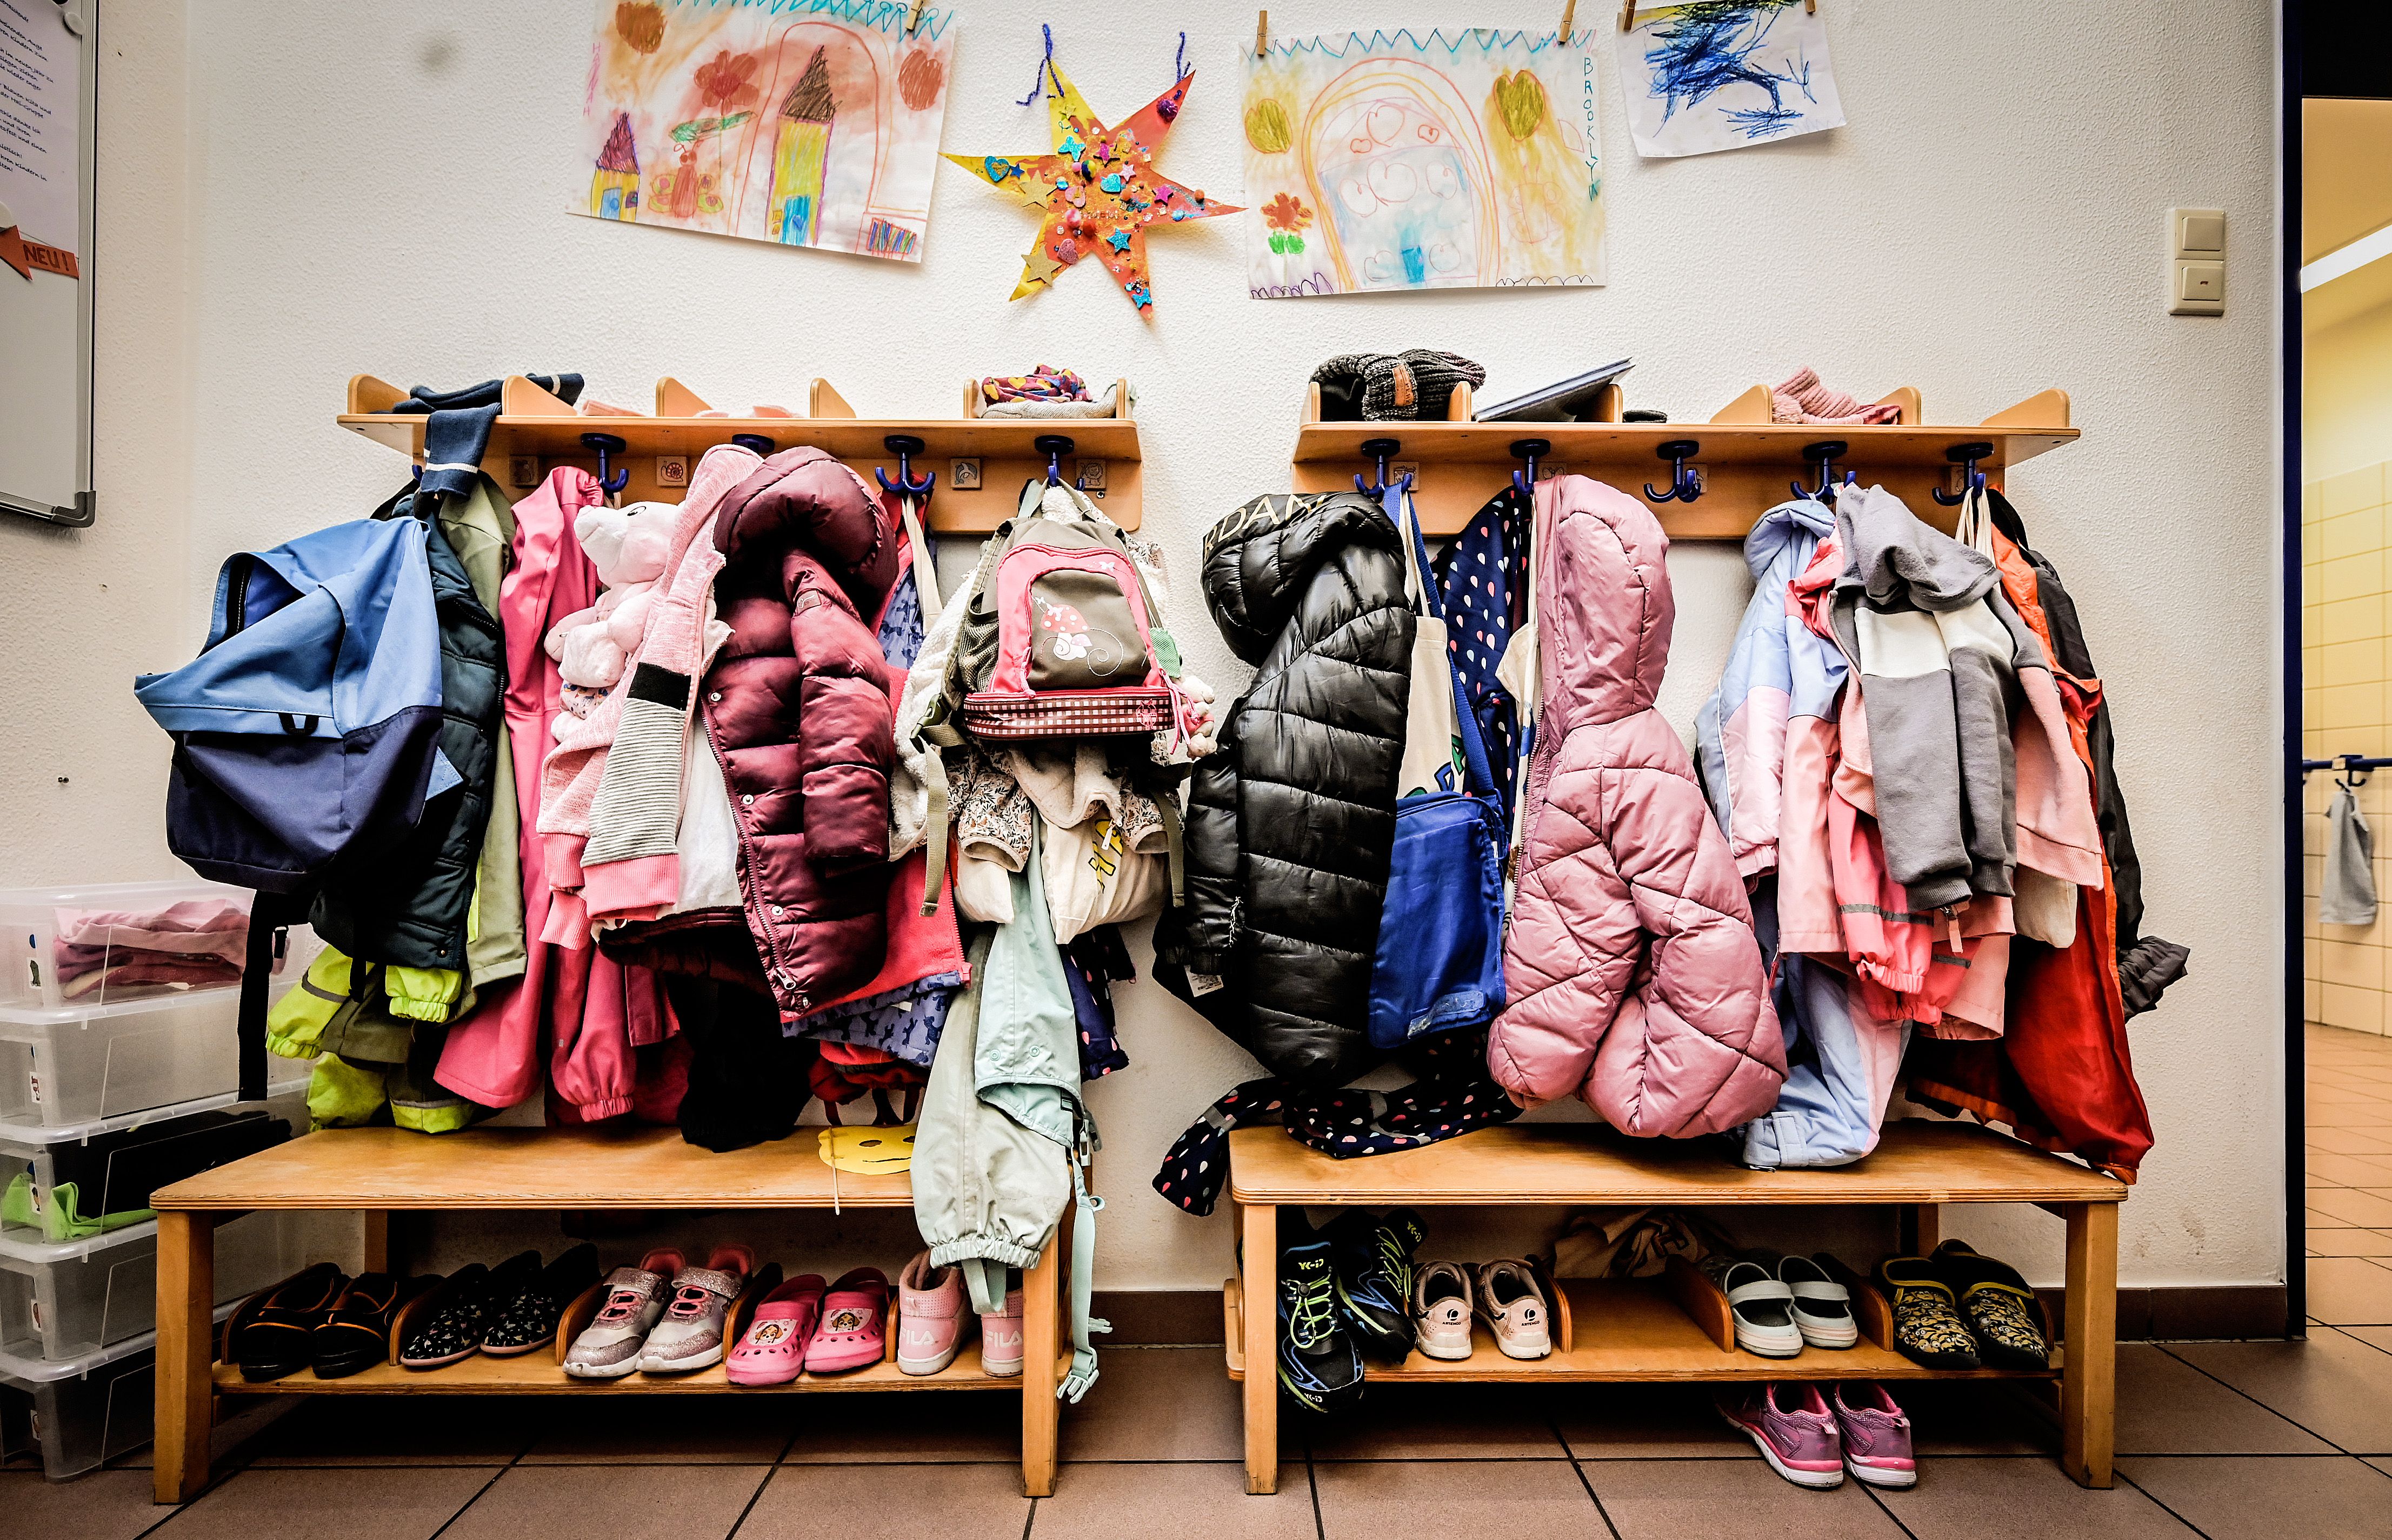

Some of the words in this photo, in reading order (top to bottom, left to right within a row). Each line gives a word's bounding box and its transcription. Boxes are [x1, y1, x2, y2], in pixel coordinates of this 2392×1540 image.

[11, 36, 33, 52] Kindern
[35, 51, 48, 62] zum
[28, 39, 43, 51] Auge
[15, 58, 32, 70] neuen
[6, 68, 24, 81] wieder
[19, 68, 37, 81] ziehen
[40, 106, 51, 115] und
[3, 119, 15, 128] und
[14, 117, 31, 130] danke
[1583, 57, 1599, 202] BROOKLYN
[18, 136, 30, 144] und
[15, 162, 39, 177] Kindern
[23, 244, 70, 271] NEU!
[901, 1326, 935, 1346] FILA
[985, 1329, 1023, 1348] FILA
